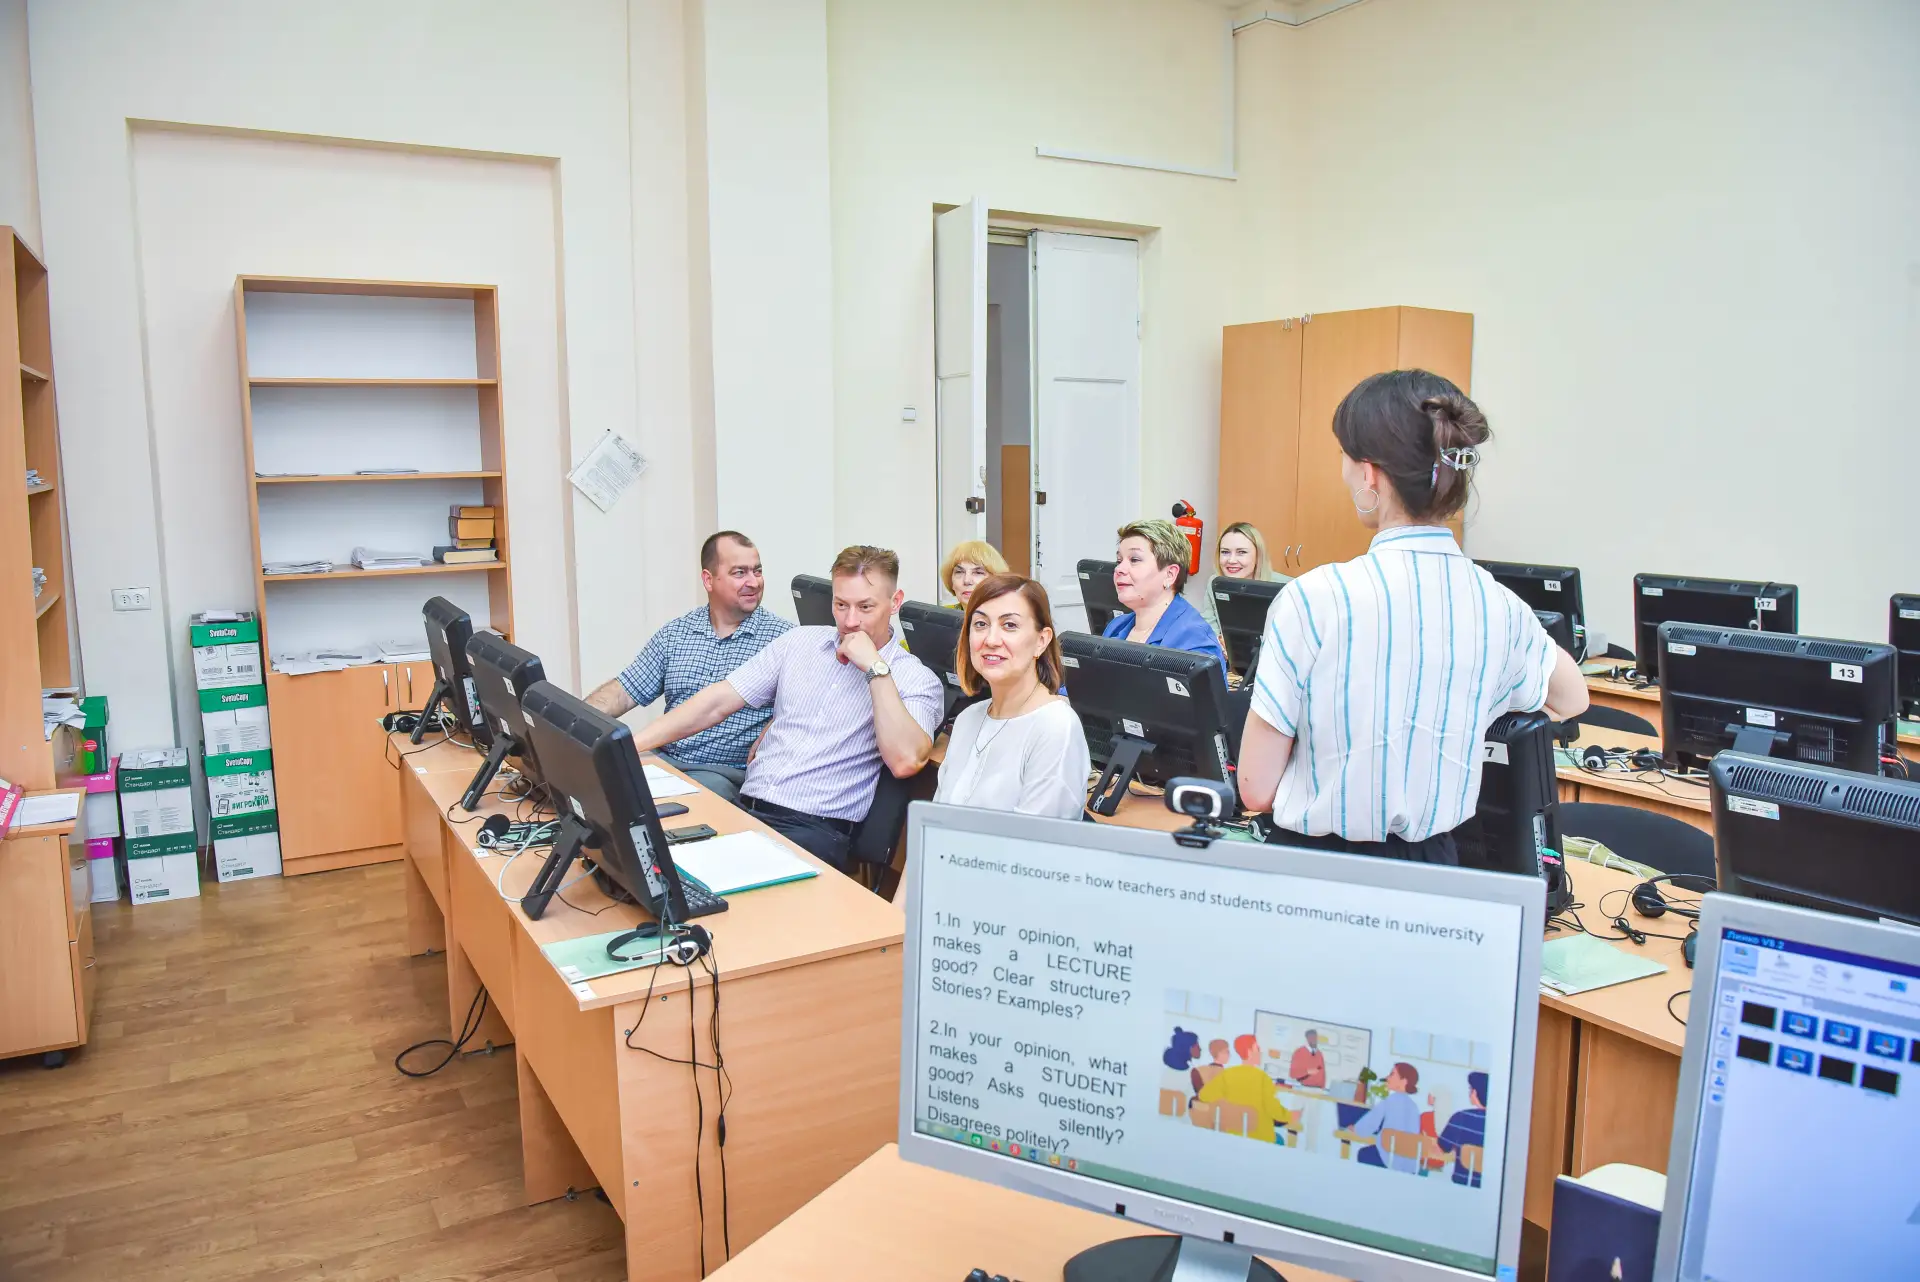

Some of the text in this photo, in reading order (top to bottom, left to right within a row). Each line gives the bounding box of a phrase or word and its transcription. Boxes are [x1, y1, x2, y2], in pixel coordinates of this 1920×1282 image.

[1176, 683, 1181, 691] 6
[1839, 668, 1855, 678] 13
[225, 758, 253, 767] SvetoCopy
[1485, 746, 1494, 757] 7
[217, 827, 244, 835] Стандарт
[948, 853, 1007, 874] Academic
[1010, 863, 1070, 883] discourse
[1085, 873, 1114, 890] how
[1118, 880, 1176, 898] teachers
[1179, 889, 1206, 903] and
[1210, 892, 1273, 913] students
[1276, 903, 1380, 928] communicate
[1385, 915, 1400, 931] in
[1404, 921, 1485, 946] university
[933, 935, 1132, 983] makes a LECTURE
[934, 911, 1133, 959] 1.In your opinion, what
[931, 976, 1084, 1020] Stories? Examples?
[932, 957, 1131, 1005] good? Clear structure?
[929, 1044, 1127, 1098] makes a STUDENT
[930, 1019, 1129, 1076] 2.In your opinion, what
[928, 1065, 1125, 1120] good? Asks questions?
[928, 1085, 1125, 1145] Listens silently?
[927, 1105, 1070, 1154] Disagrees politely?
